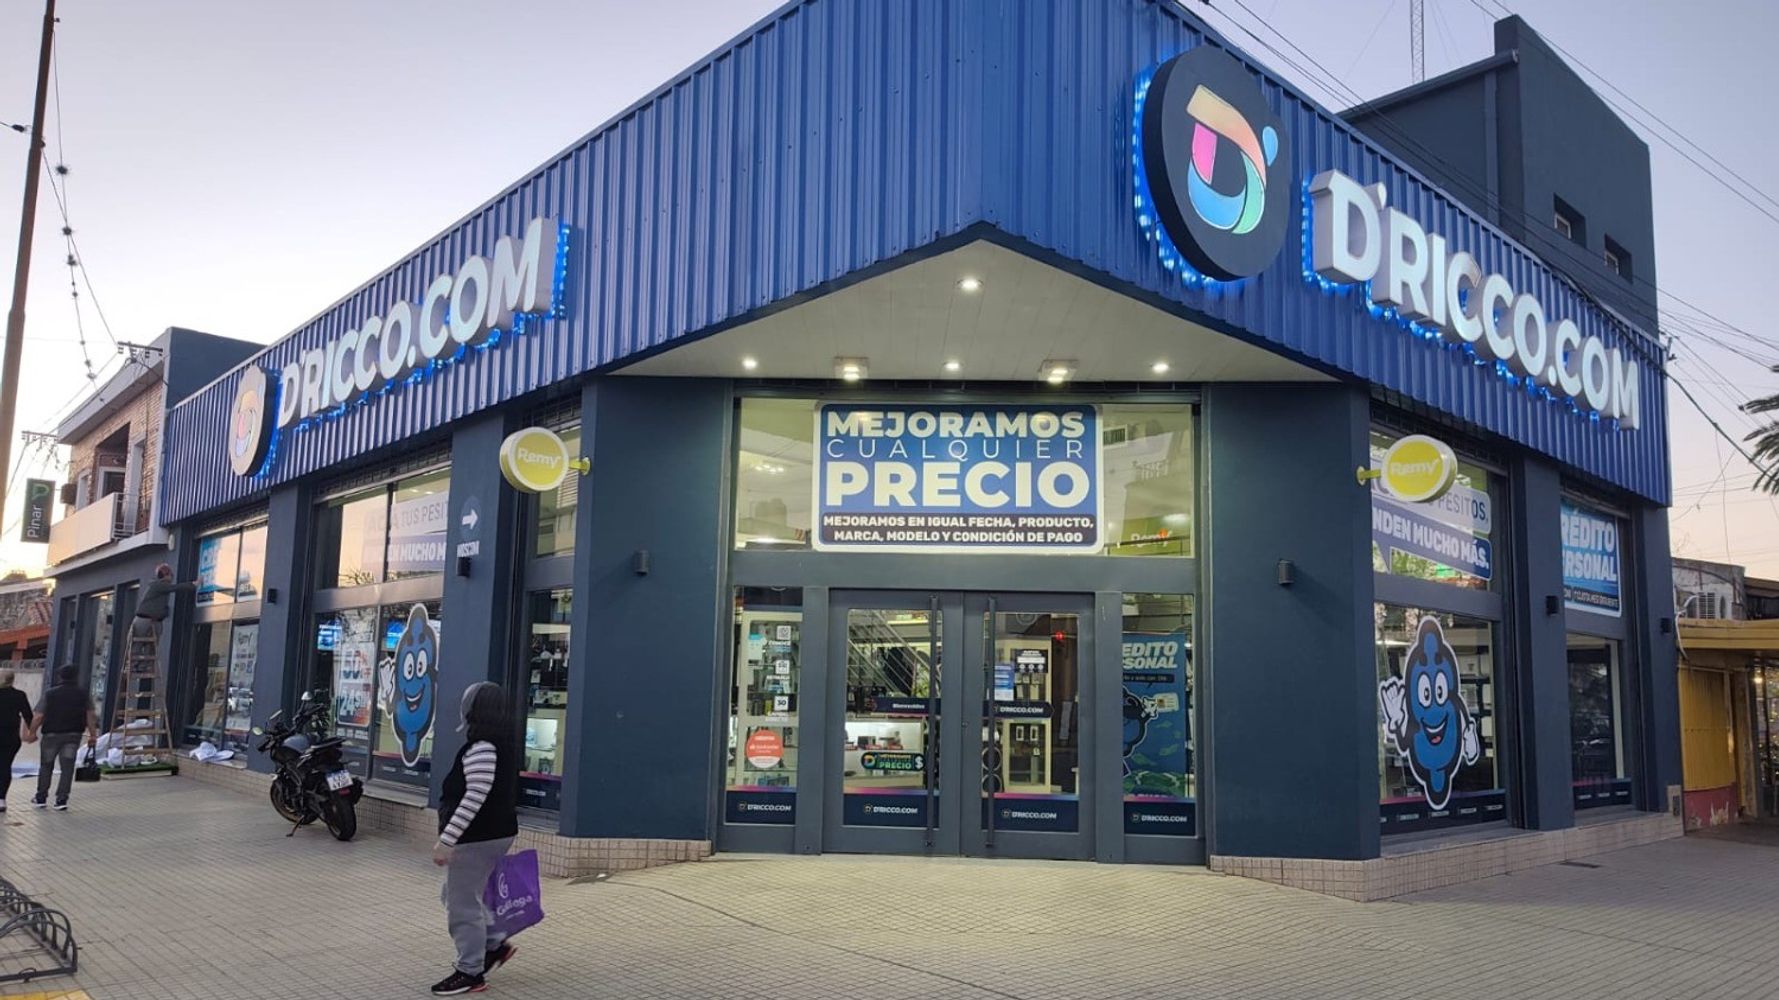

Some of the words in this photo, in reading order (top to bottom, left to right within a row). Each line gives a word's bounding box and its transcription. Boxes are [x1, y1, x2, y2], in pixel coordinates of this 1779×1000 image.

[1312, 169, 1640, 430] D'RICCO.COM
[277, 216, 553, 429] D'RICCO.COM
[827, 410, 1086, 439] MEJORAMOS
[517, 447, 562, 469] Remy
[826, 439, 1083, 462] CUALQUIER
[1391, 457, 1441, 476] Remy
[825, 461, 1090, 508] PRECIO
[26, 504, 43, 538] Pinar
[422, 499, 448, 521] PESI
[824, 515, 905, 527] MEJORAMOS
[908, 516, 925, 527] EN
[928, 516, 966, 528] IGUAL
[968, 517, 1016, 530] FECHA,
[1019, 517, 1094, 529] PRODUCTO,
[1561, 507, 1616, 553] RÉDITO
[834, 530, 883, 543] MARCA,
[886, 531, 939, 542] MODELO
[942, 532, 950, 542] Y
[952, 529, 1026, 543] CONDICIÓN
[1029, 532, 1045, 543] DE
[1047, 532, 1083, 543] PAGO
[1372, 507, 1412, 542] NDEN
[1412, 522, 1460, 559] MUCHO
[1460, 539, 1490, 569] MÁS.
[1562, 549, 1617, 581] RSONAL
[1122, 641, 1178, 657] EDITO
[1122, 656, 1178, 669] SONAL
[879, 761, 912, 770] PRECIO
